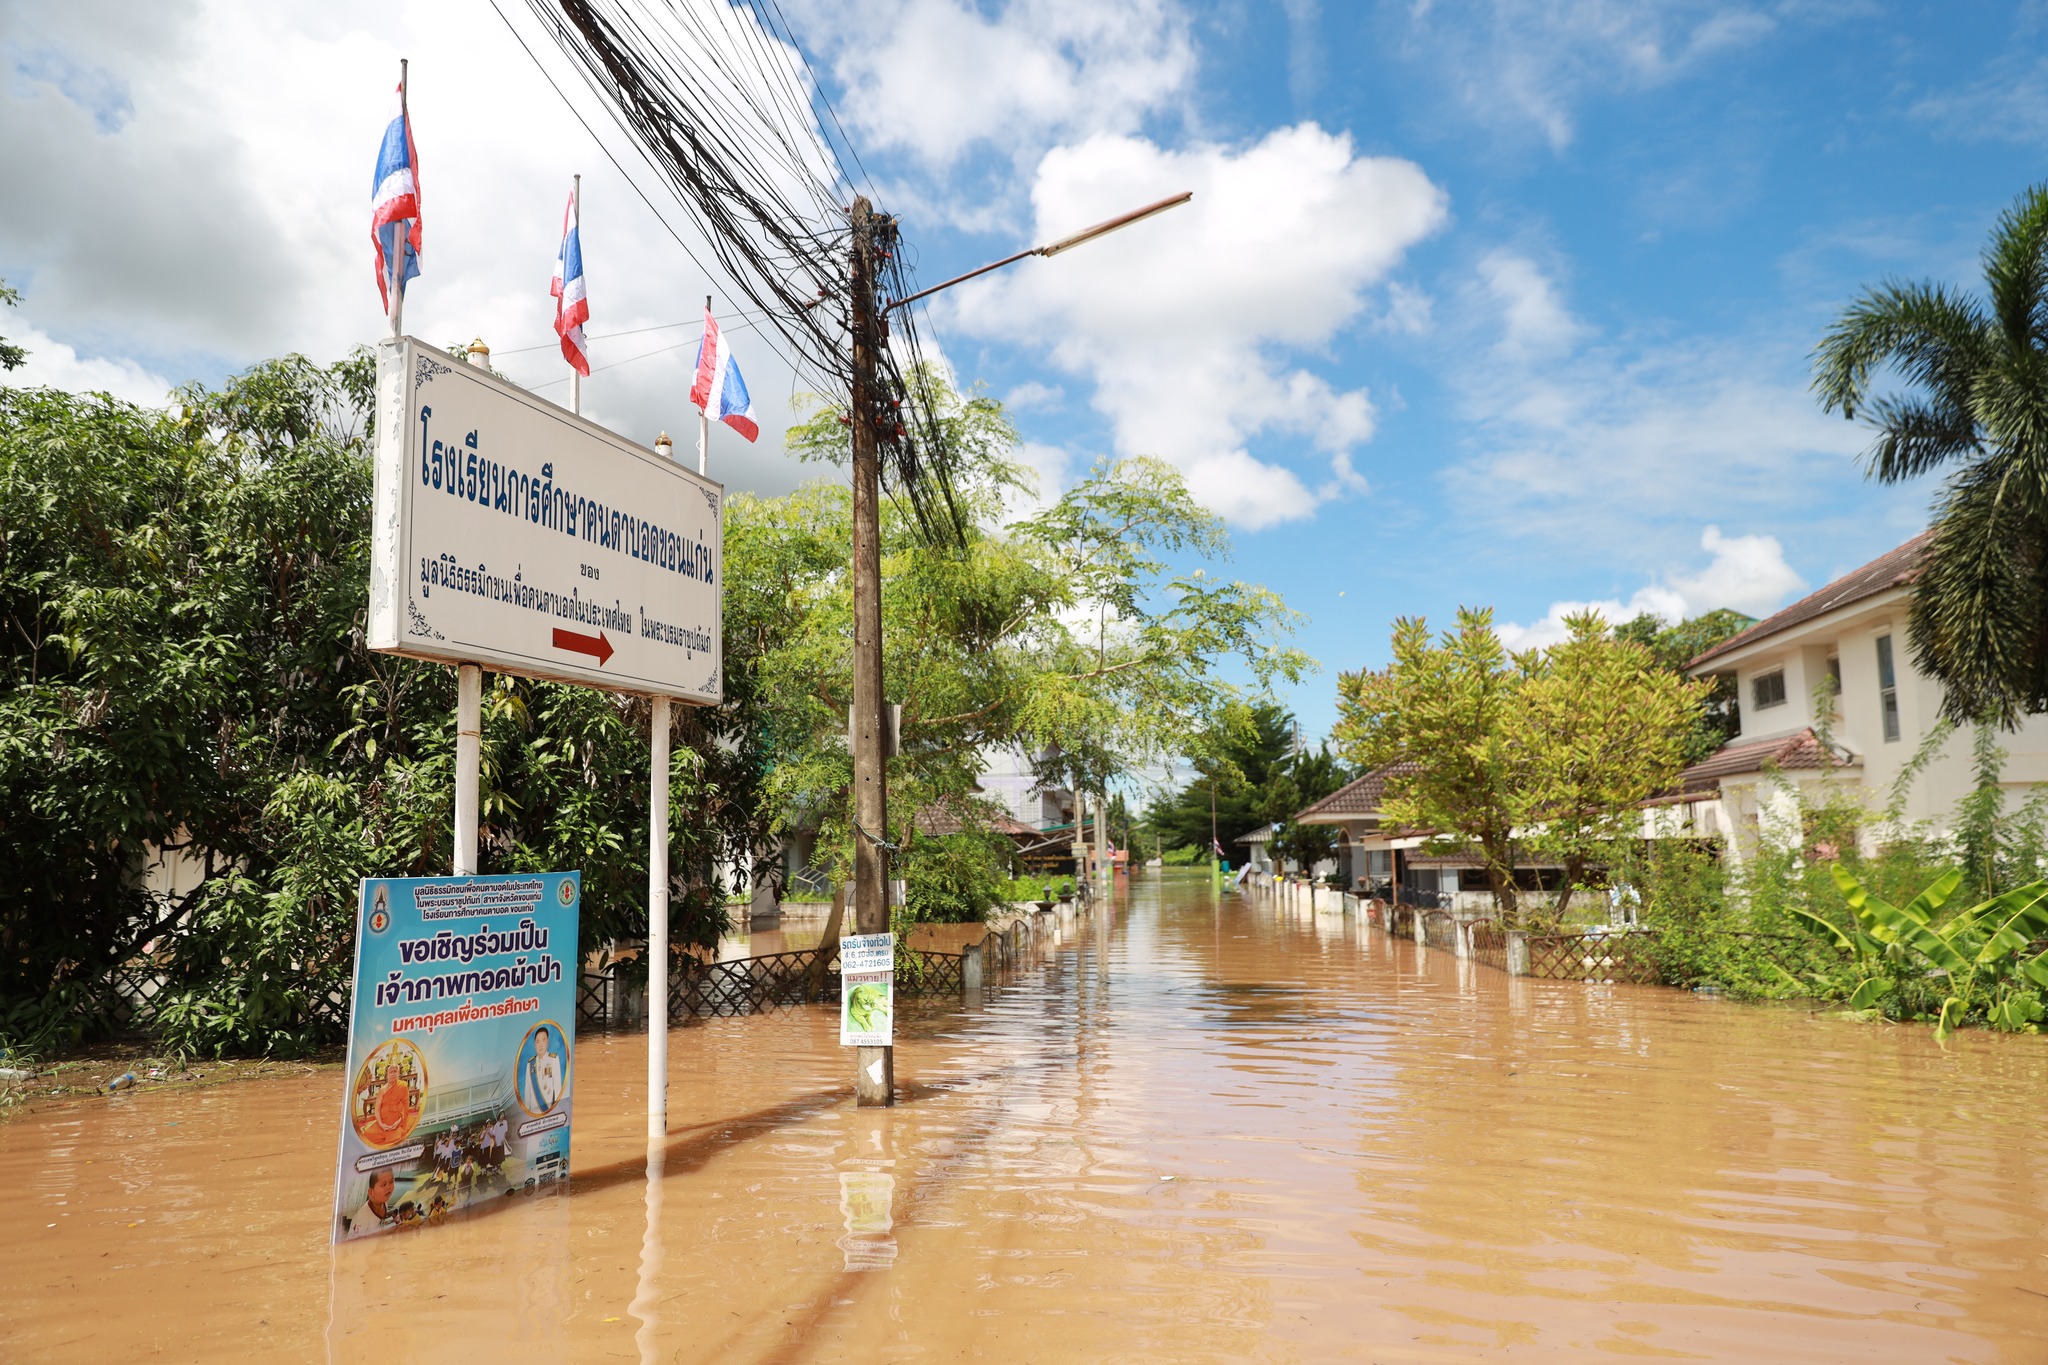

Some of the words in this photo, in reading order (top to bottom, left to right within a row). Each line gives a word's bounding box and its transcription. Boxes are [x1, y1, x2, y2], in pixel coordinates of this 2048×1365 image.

[421, 405, 713, 585] โรงเรียนการศึกษาคนตาบอดขอนแก่น
[580, 563, 600, 580] ของ
[640, 606, 711, 660] ในพระบรมราชูปถัมภ์
[414, 881, 543, 897] มูลนิธิธรรมิกชนเพื่อคนตาบอดในประเทศไทย
[483, 891, 542, 903] สาขาจังหวัดขอนแก่น
[423, 906, 509, 919] โรงเรียนการศึกษาคนตาบอด
[510, 903, 534, 913] ขอนแก่น
[400, 919, 548, 963] ขอเชิญร่วมเป็น
[842, 934, 891, 949] รถรับจ้างทั่วไป
[843, 958, 890, 969] 062-4721605
[376, 955, 561, 1006] เจ้าภาพทอดผ้าป่า
[393, 997, 539, 1032] มหากุศลเพื่อการศึกษา
